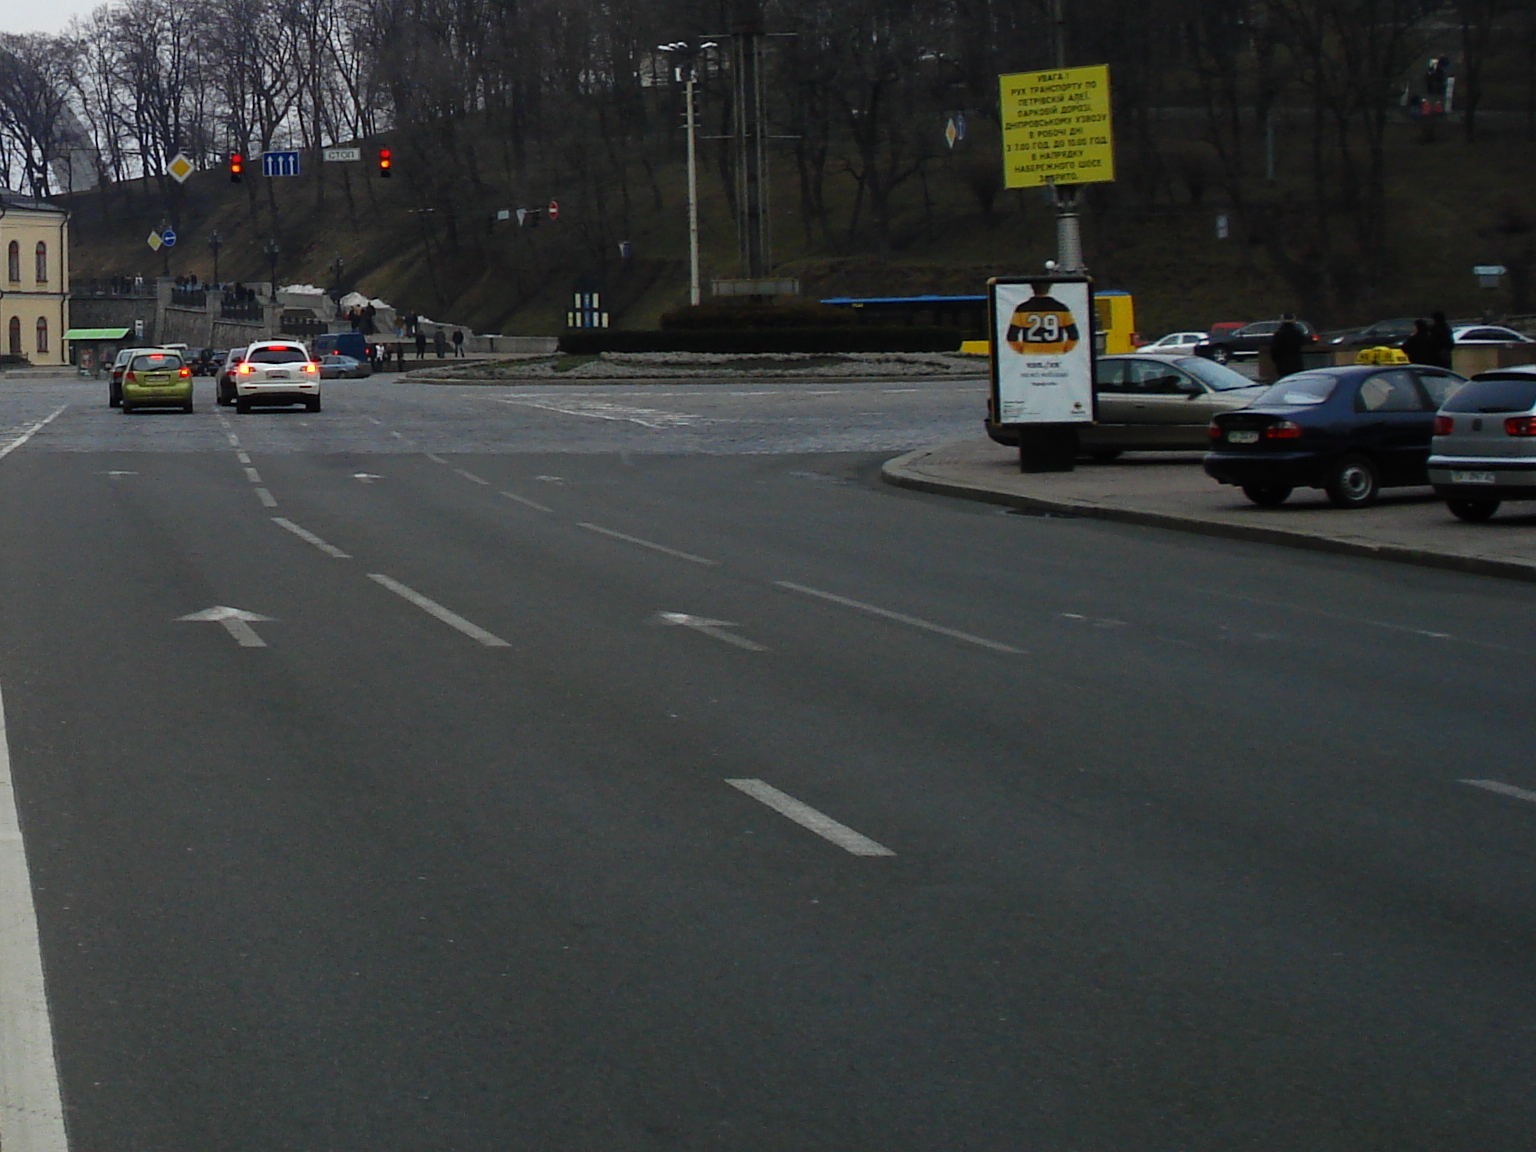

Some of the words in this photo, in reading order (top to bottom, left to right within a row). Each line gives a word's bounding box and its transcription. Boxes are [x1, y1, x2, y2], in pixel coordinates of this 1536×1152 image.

[1037, 73, 1063, 82] УВАГА
[1011, 88, 1026, 96] РУХ
[1029, 82, 1083, 94] ТРАНСПОРТУ
[1085, 81, 1097, 89] ПО
[1017, 106, 1057, 117] ПАРКОВІЙ
[1075, 114, 1107, 123] УЗВОЗУ
[1037, 129, 1066, 137] РОБОЧІ
[1069, 127, 1083, 135] ДНІ
[328, 151, 354, 160] СТОП
[1014, 161, 1075, 173] НАБЕРЕЖНОГО
[1078, 159, 1103, 168] ШОСЕ
[1026, 313, 1059, 342] 29
